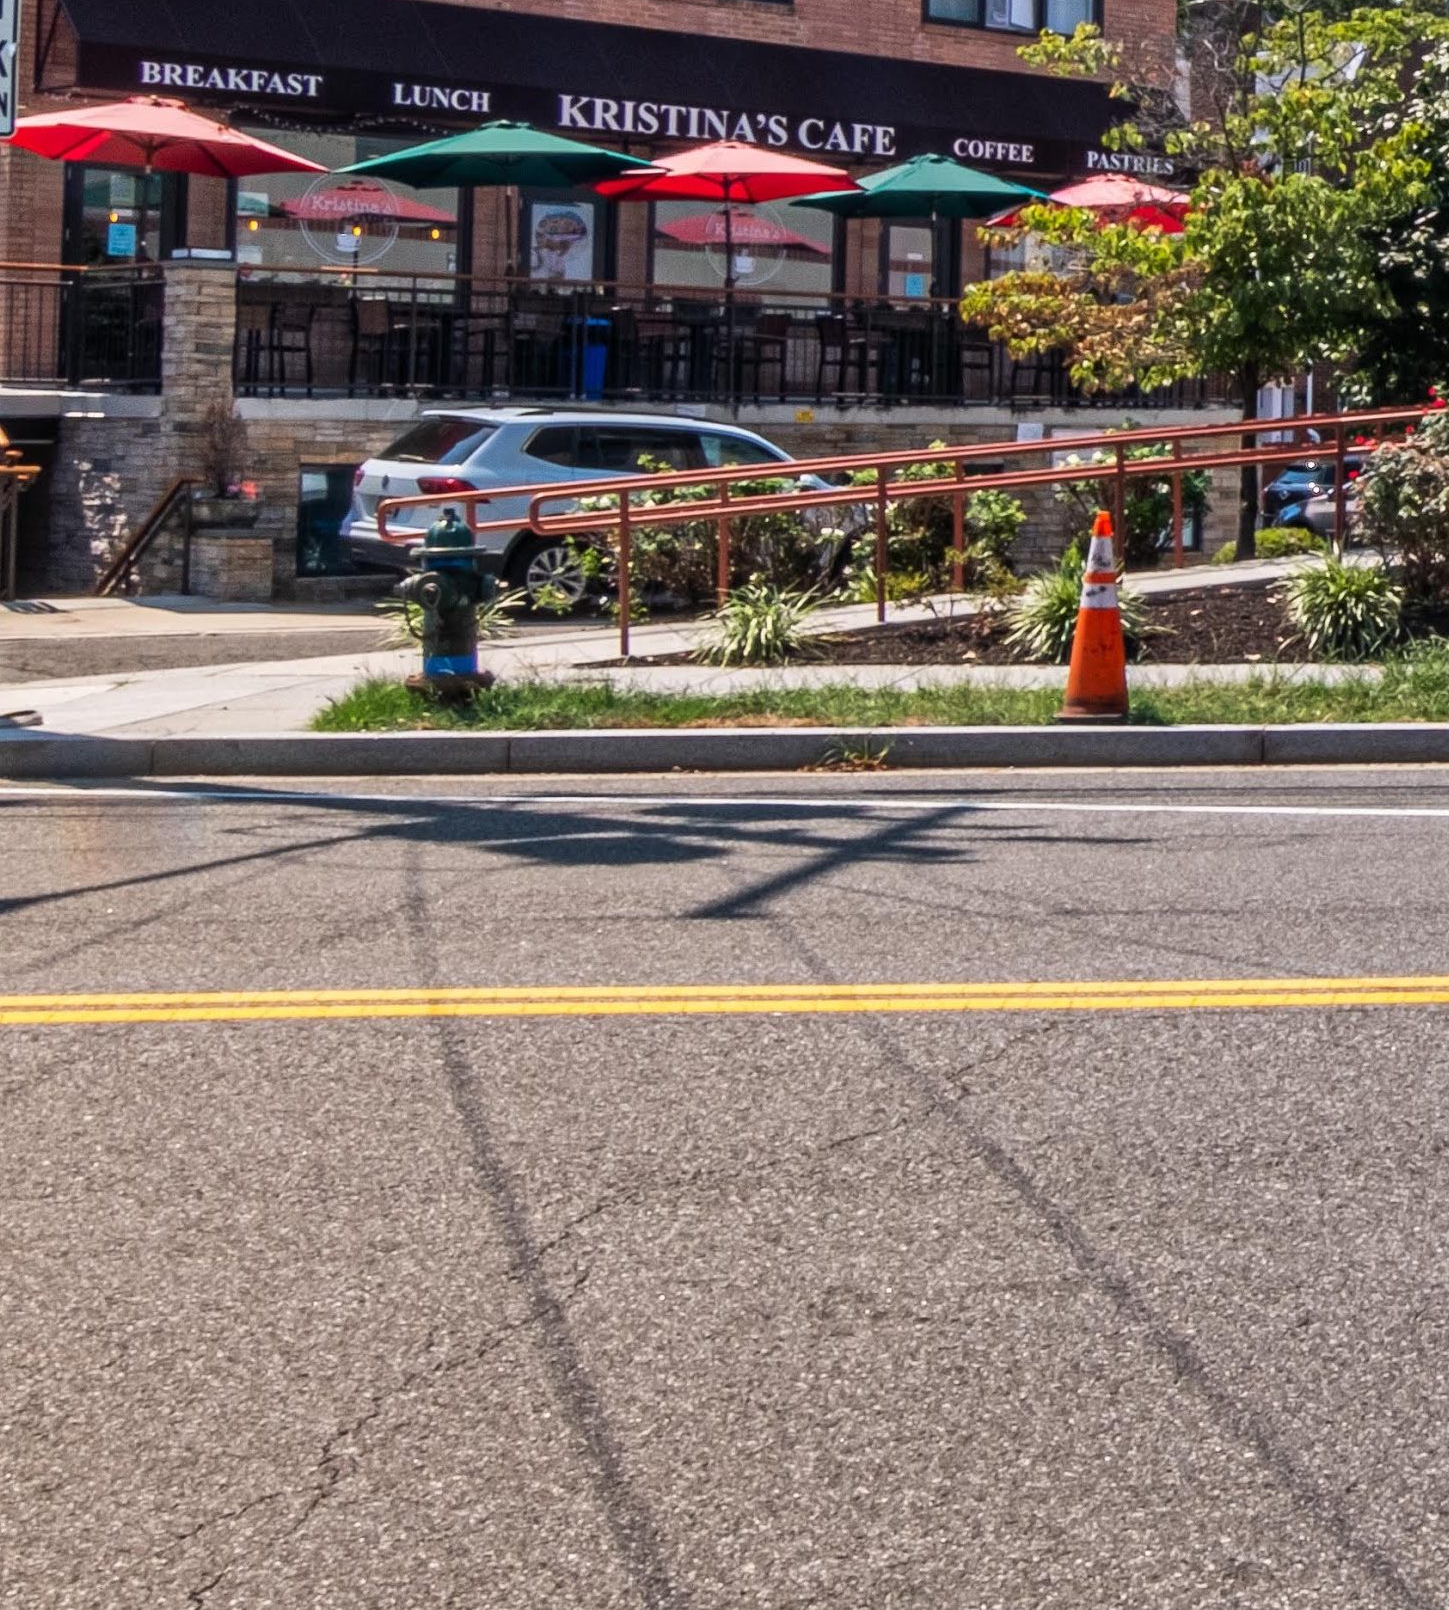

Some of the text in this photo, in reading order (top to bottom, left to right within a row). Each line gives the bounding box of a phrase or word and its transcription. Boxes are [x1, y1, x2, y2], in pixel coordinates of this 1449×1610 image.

[140, 60, 324, 97] BREAKFAST
[393, 83, 492, 113] LUNCH
[558, 94, 897, 156] KRISTINA'S CAFE
[953, 138, 1034, 163] COFFEE
[1086, 150, 1175, 175] PASTRIES
